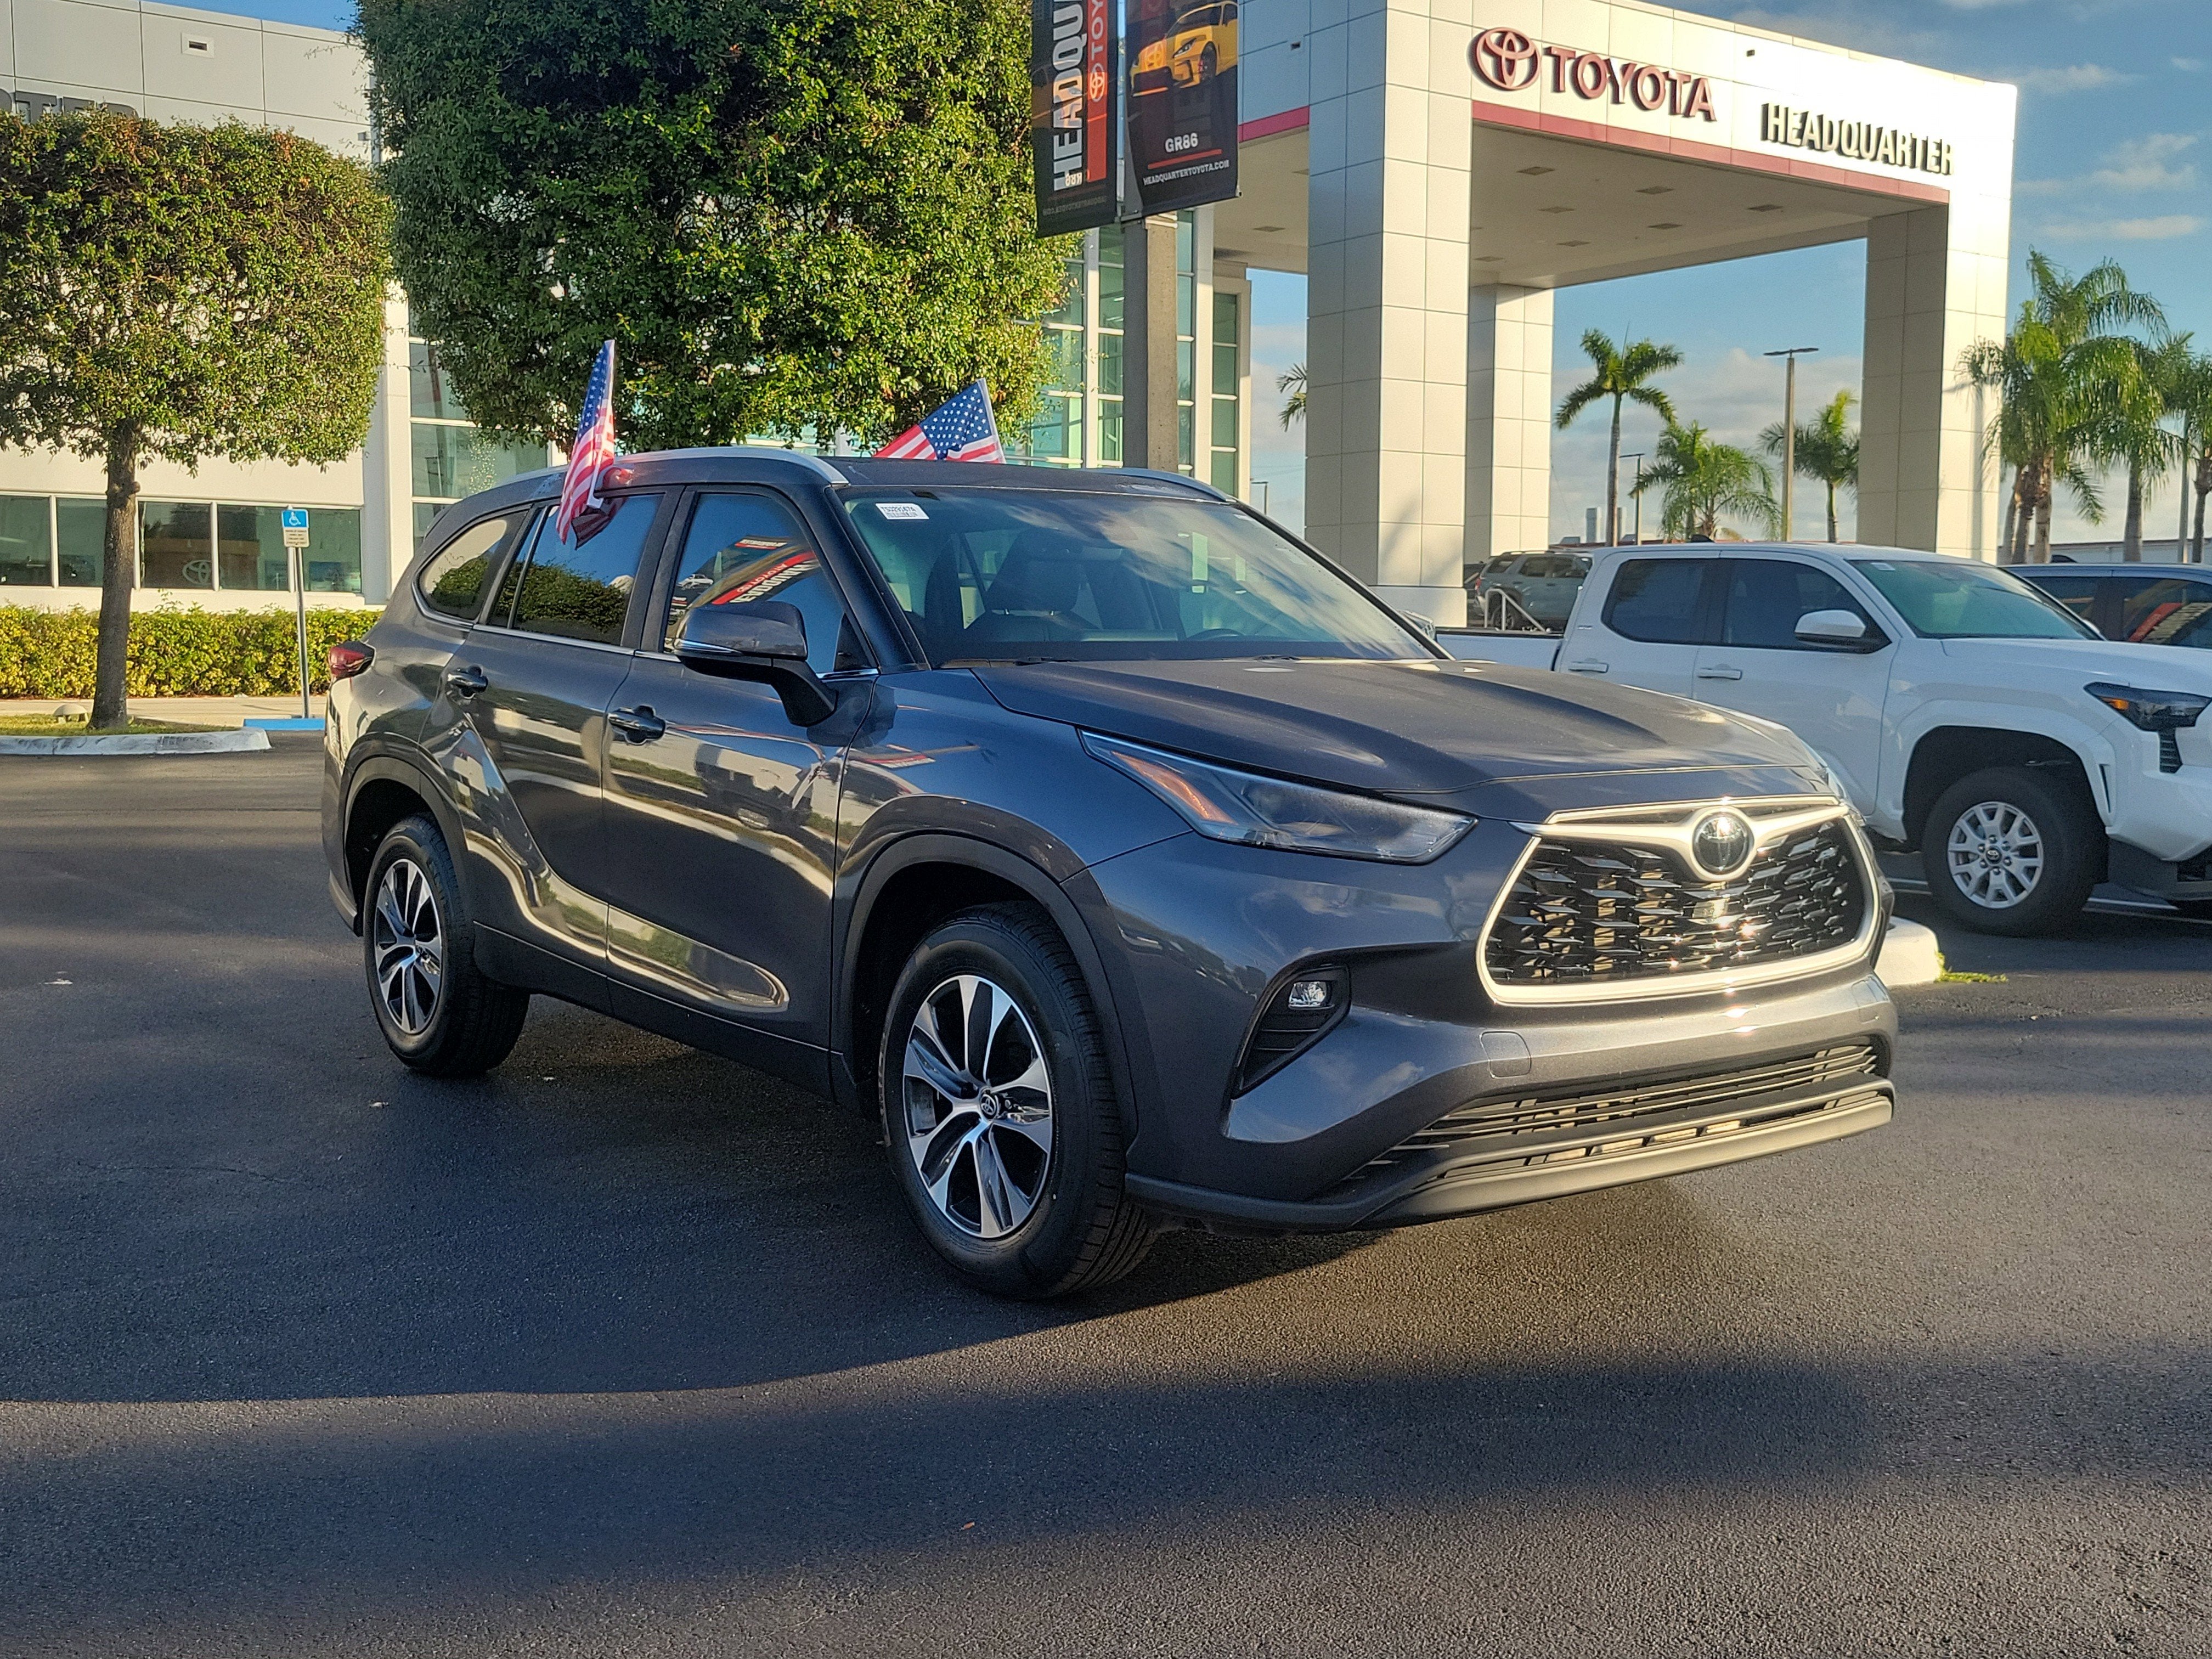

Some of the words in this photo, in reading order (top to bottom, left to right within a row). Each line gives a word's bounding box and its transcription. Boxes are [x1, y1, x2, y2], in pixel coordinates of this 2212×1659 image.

[1053, 0, 1087, 191] HEADQU
[1542, 46, 1718, 122] TOYOTA
[1143, 159, 1230, 186] HEADQUARTERTOYOTA.COM
[1165, 132, 1199, 153] GR86
[1760, 103, 1955, 176] HEADQUARTER
